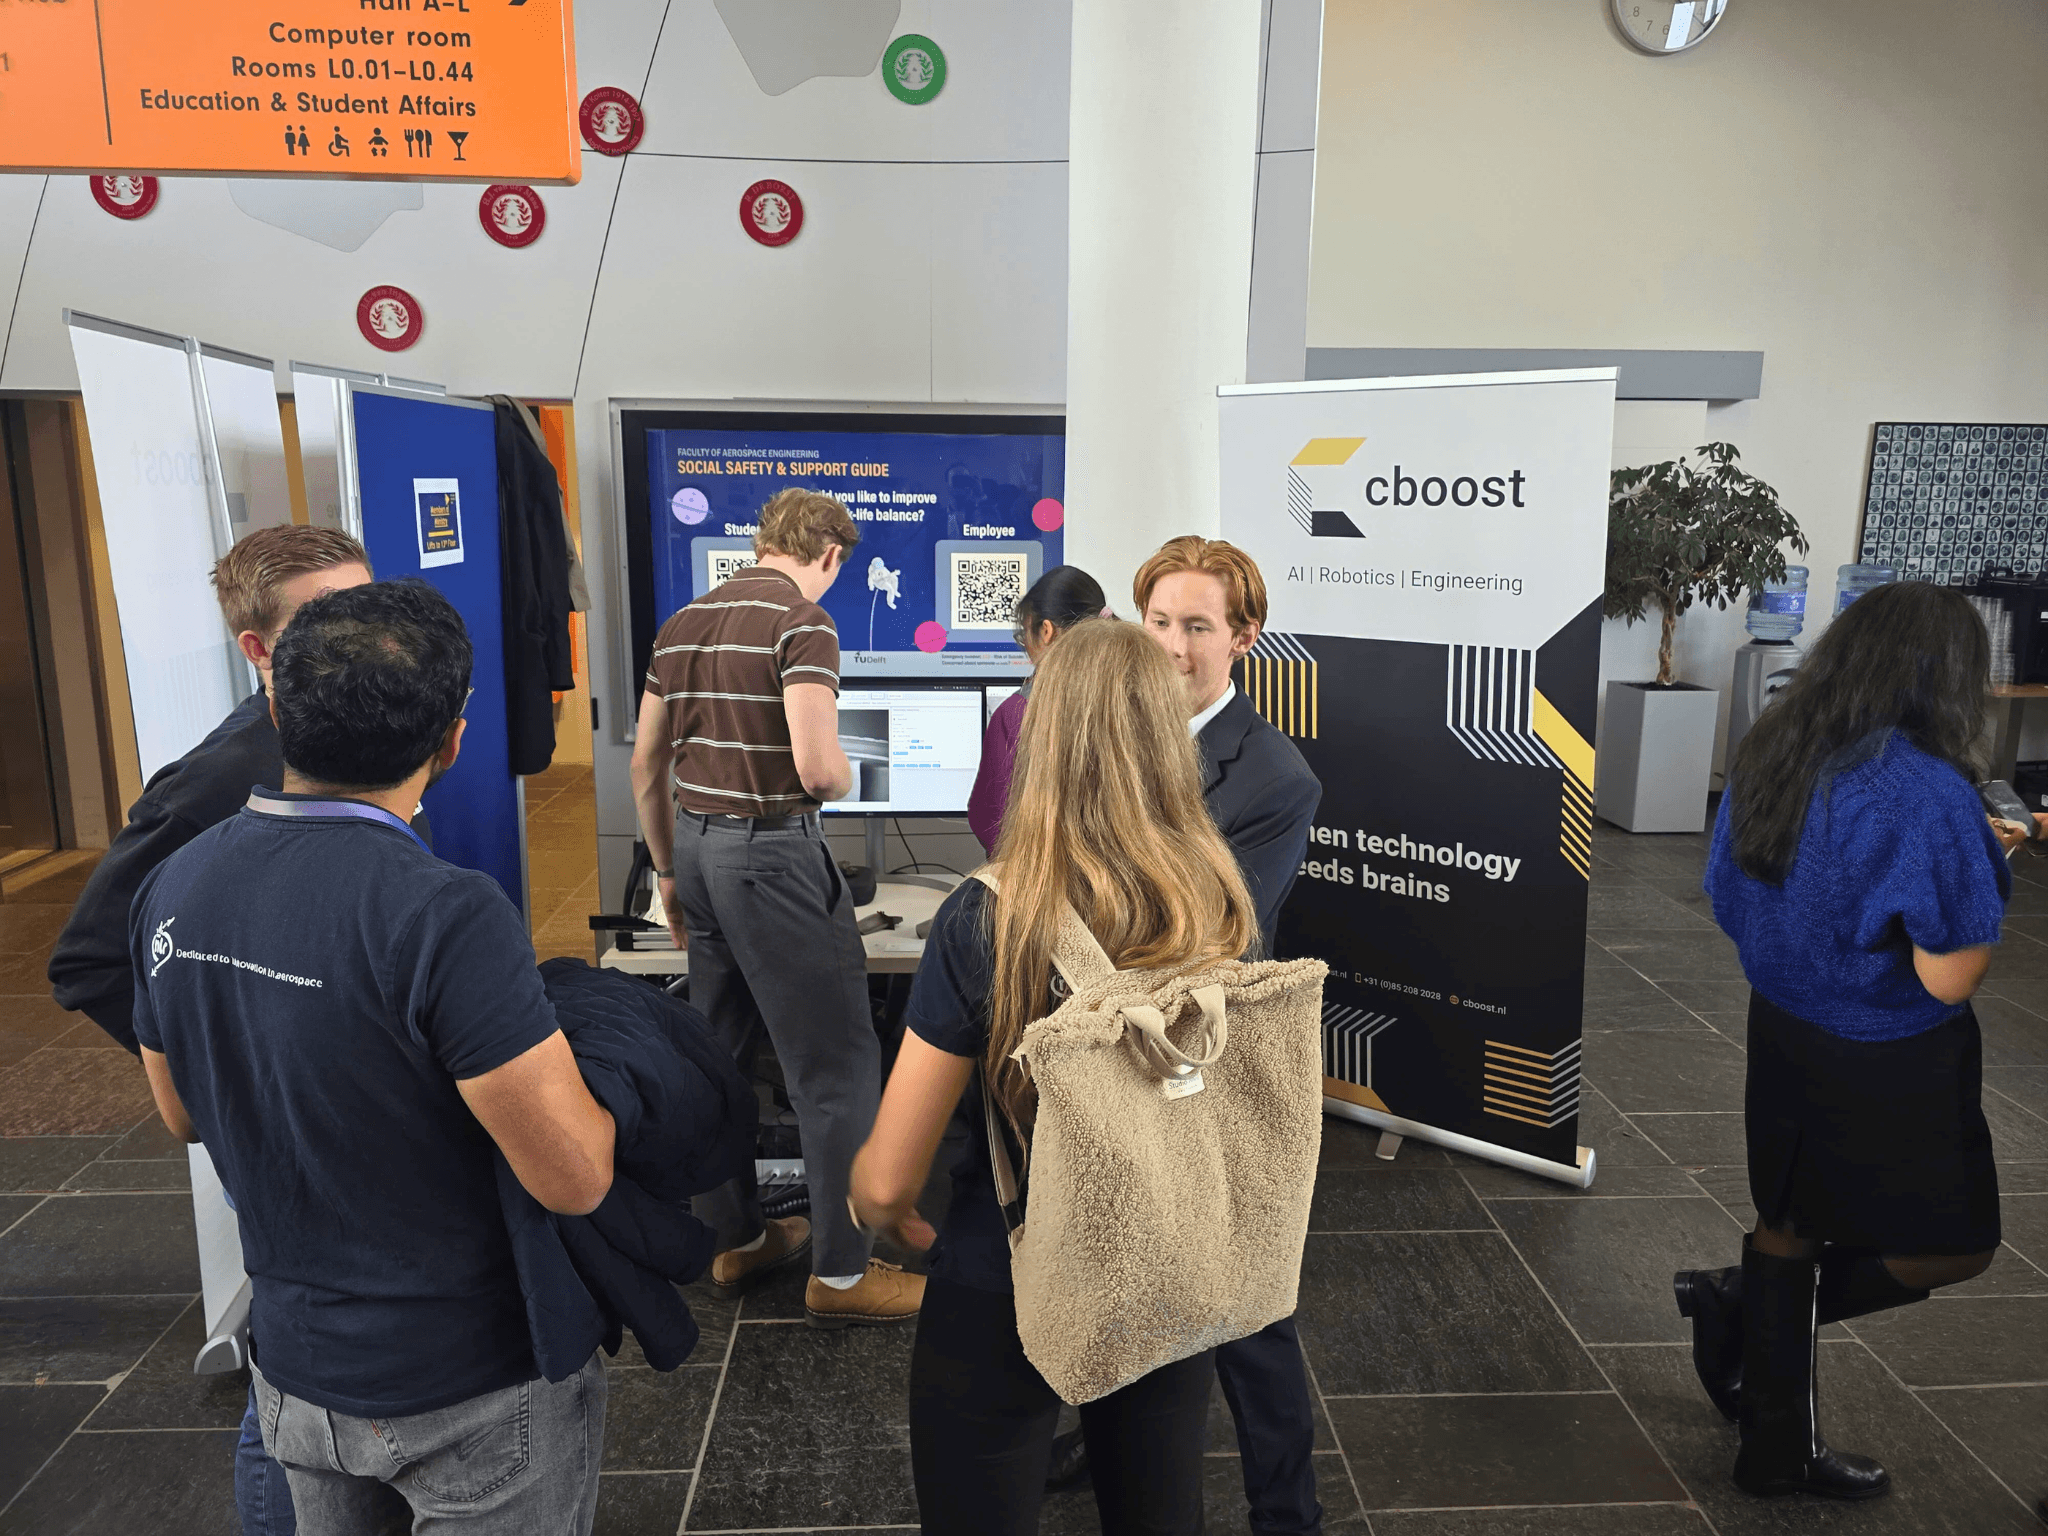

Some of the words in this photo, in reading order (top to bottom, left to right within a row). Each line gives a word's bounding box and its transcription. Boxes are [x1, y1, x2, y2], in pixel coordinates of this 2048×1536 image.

[1633, 6, 1640, 17] 8
[269, 22, 394, 49] Computer
[407, 31, 471, 47] room
[1647, 20, 1653, 31] 7
[232, 56, 316, 79] Rooms
[140, 88, 260, 112] Education
[270, 92, 287, 112] &
[297, 91, 389, 114] Student
[399, 94, 476, 117] Affairs
[677, 448, 710, 457] FACULTY
[710, 448, 721, 457] OF
[722, 448, 767, 457] AEROSPACE
[768, 449, 820, 459] ENGINEERING
[677, 460, 724, 474] SOCIAL
[725, 461, 774, 475] SAFETY
[776, 461, 787, 476] &
[790, 462, 848, 476] SUPPORT
[850, 463, 889, 477] GUIDE
[834, 491, 855, 503] you
[857, 490, 877, 503] like
[879, 491, 891, 503] to
[892, 490, 937, 506] improve
[1366, 465, 1526, 508] cboost
[876, 508, 925, 522] balance?
[963, 523, 1016, 539] Employee
[1288, 566, 1304, 582] AI
[1319, 567, 1395, 587] Robotics
[1411, 570, 1523, 596] Engineering
[1356, 829, 1521, 883] technology
[1363, 863, 1450, 903] brains
[1363, 977, 1378, 986] +31
[1380, 980, 1401, 991] (0)85
[1403, 985, 1418, 995] 208
[1420, 989, 1441, 1000] 2028
[1462, 999, 1507, 1015] cboost.nl
